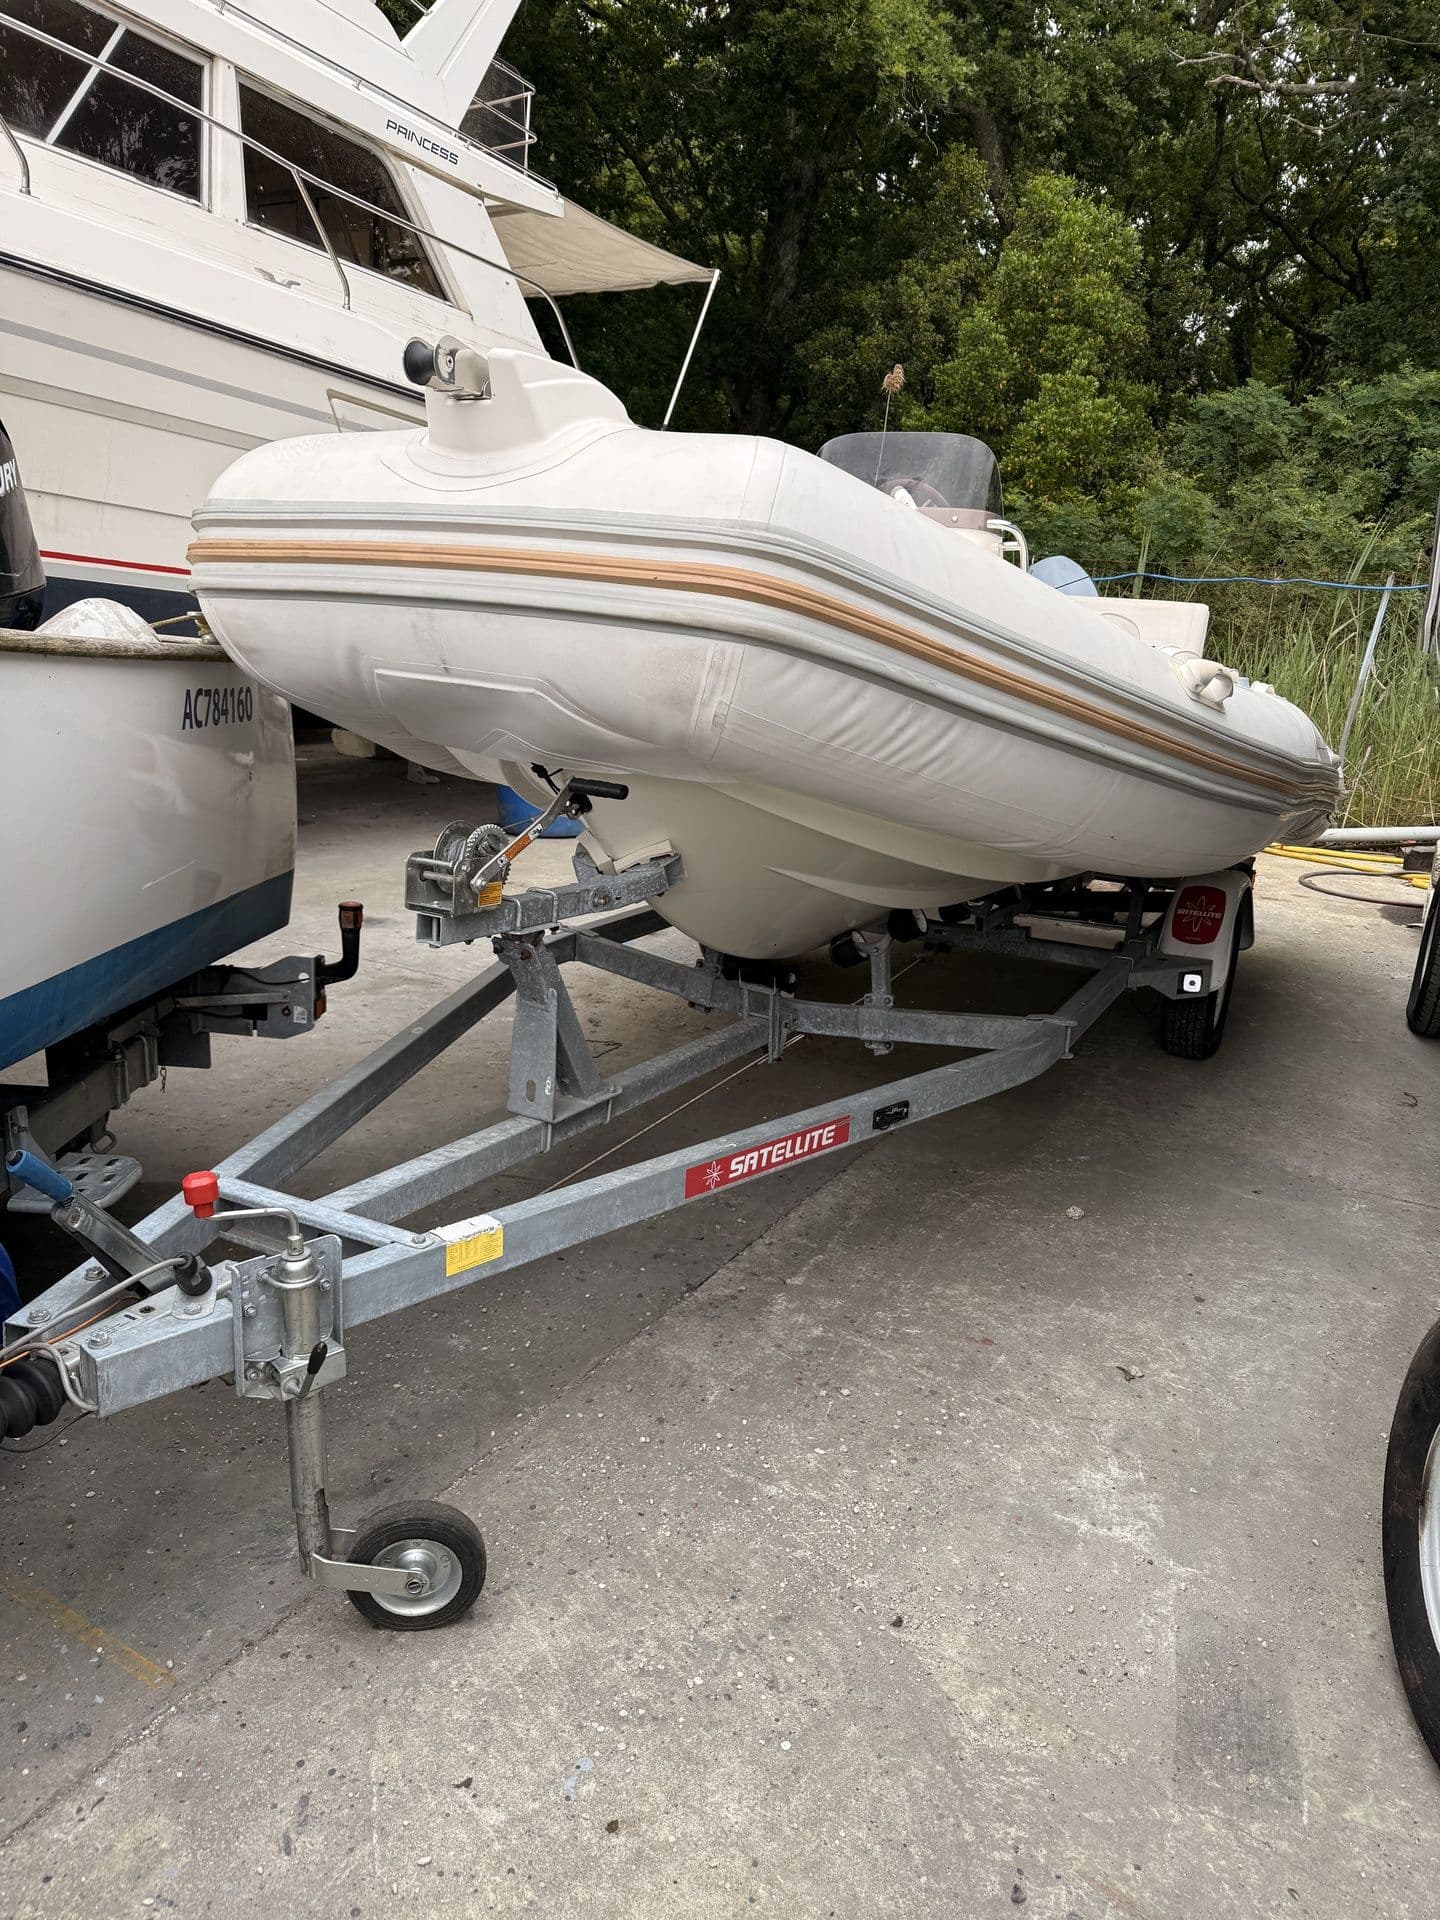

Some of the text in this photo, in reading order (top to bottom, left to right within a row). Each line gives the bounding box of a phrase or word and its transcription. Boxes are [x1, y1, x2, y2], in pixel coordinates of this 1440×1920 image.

[386, 119, 459, 165] PRINCESS
[182, 686, 253, 730] AC784160
[728, 1124, 836, 1179] SATELLITE
